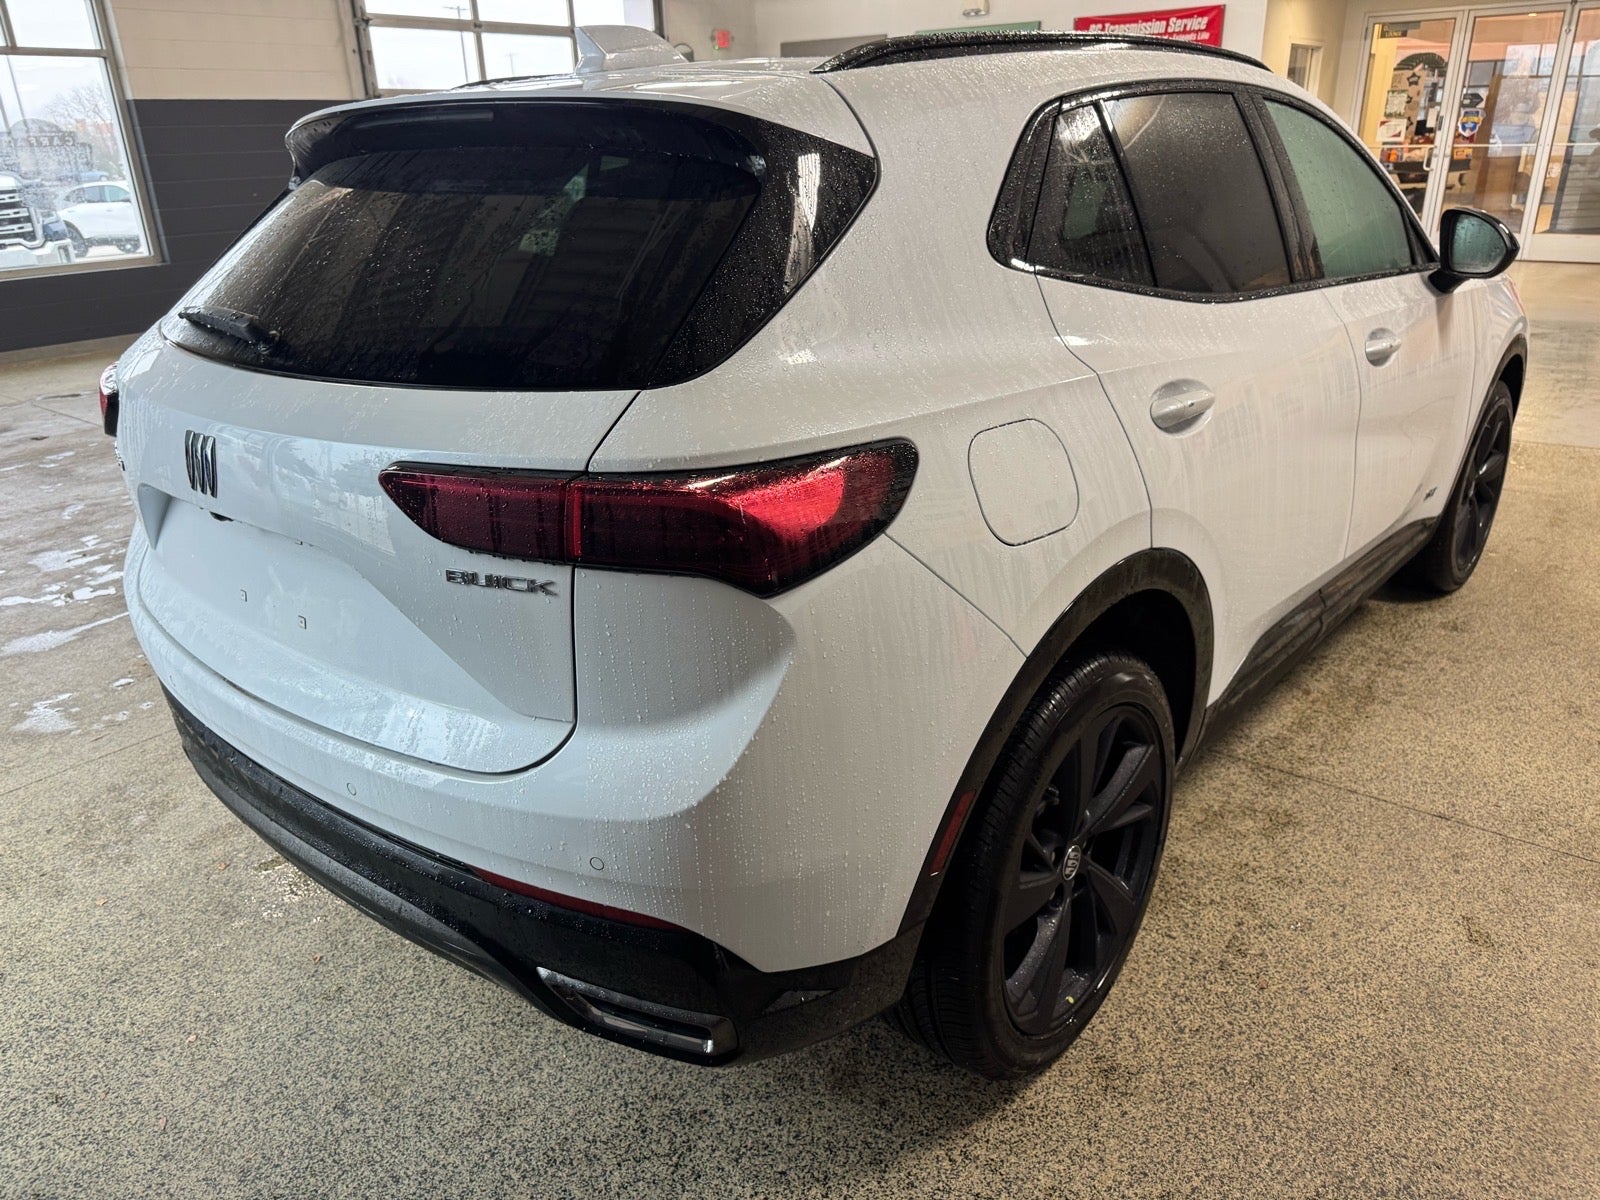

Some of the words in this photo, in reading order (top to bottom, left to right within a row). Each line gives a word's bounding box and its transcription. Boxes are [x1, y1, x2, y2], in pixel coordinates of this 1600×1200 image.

[1104, 18, 1167, 35] Transmission
[1168, 15, 1209, 33] Service
[445, 568, 559, 596] BUICK
